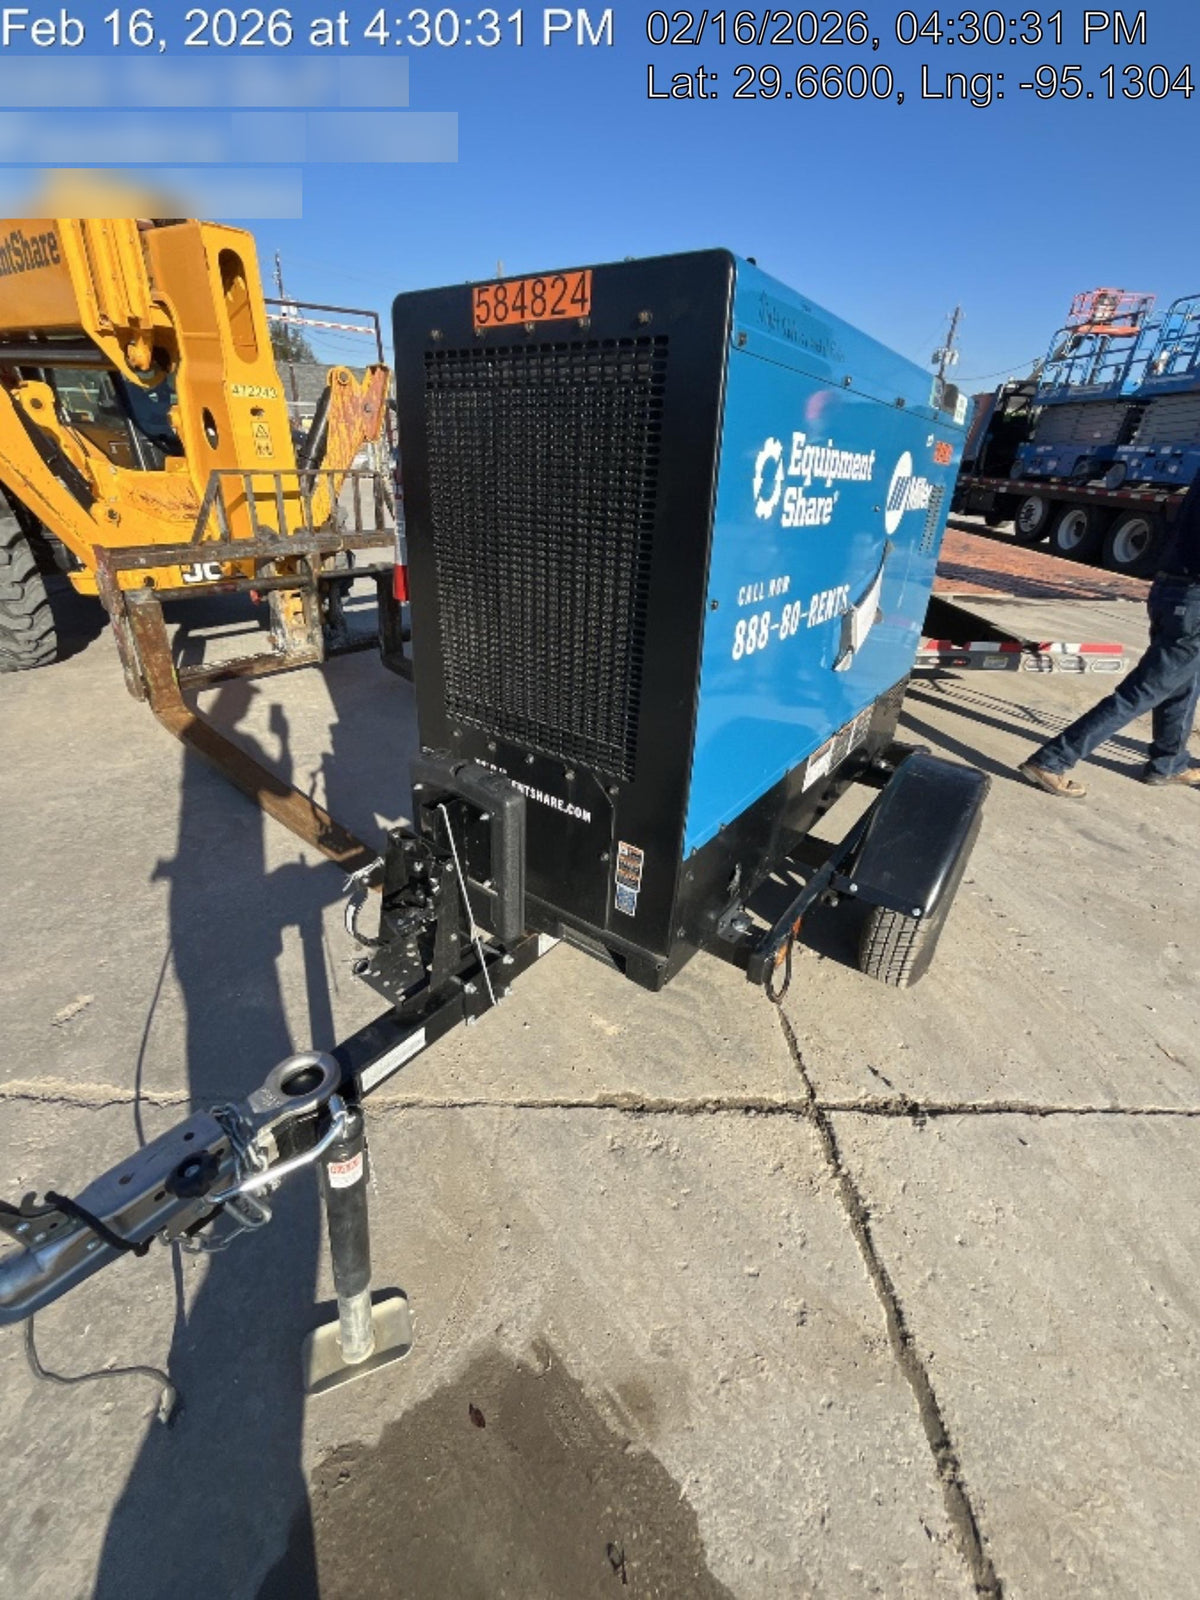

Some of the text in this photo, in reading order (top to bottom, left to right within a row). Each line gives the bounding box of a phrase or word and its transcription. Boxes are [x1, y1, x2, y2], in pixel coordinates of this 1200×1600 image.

[475, 271, 588, 324] 584824
[788, 431, 876, 488] Equipment
[183, 561, 223, 583] JC
[738, 581, 764, 607] CALL
[732, 583, 850, 661] 888-80-RENTS
